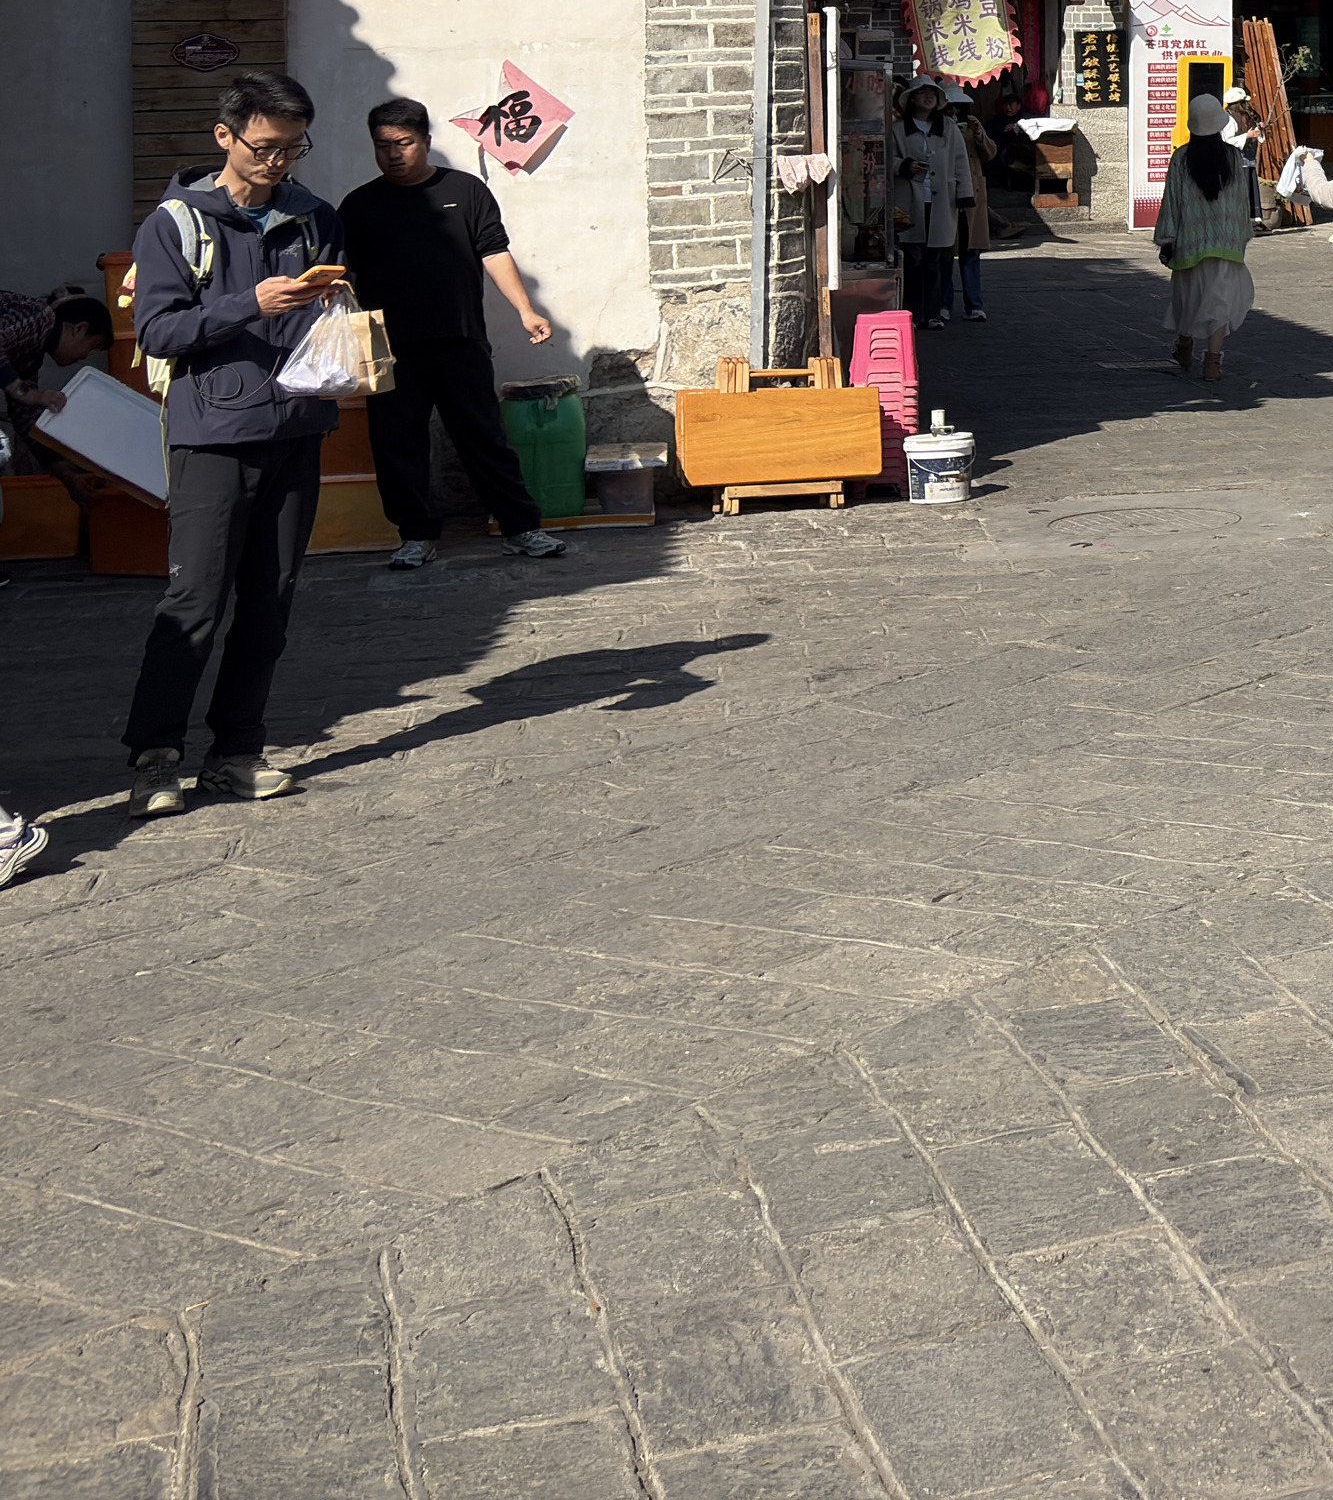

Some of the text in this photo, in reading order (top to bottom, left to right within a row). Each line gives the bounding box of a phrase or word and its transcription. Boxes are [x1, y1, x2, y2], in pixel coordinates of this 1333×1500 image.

[1145, 39, 1207, 49] 苍洱党旗红
[477, 90, 542, 147] 福
